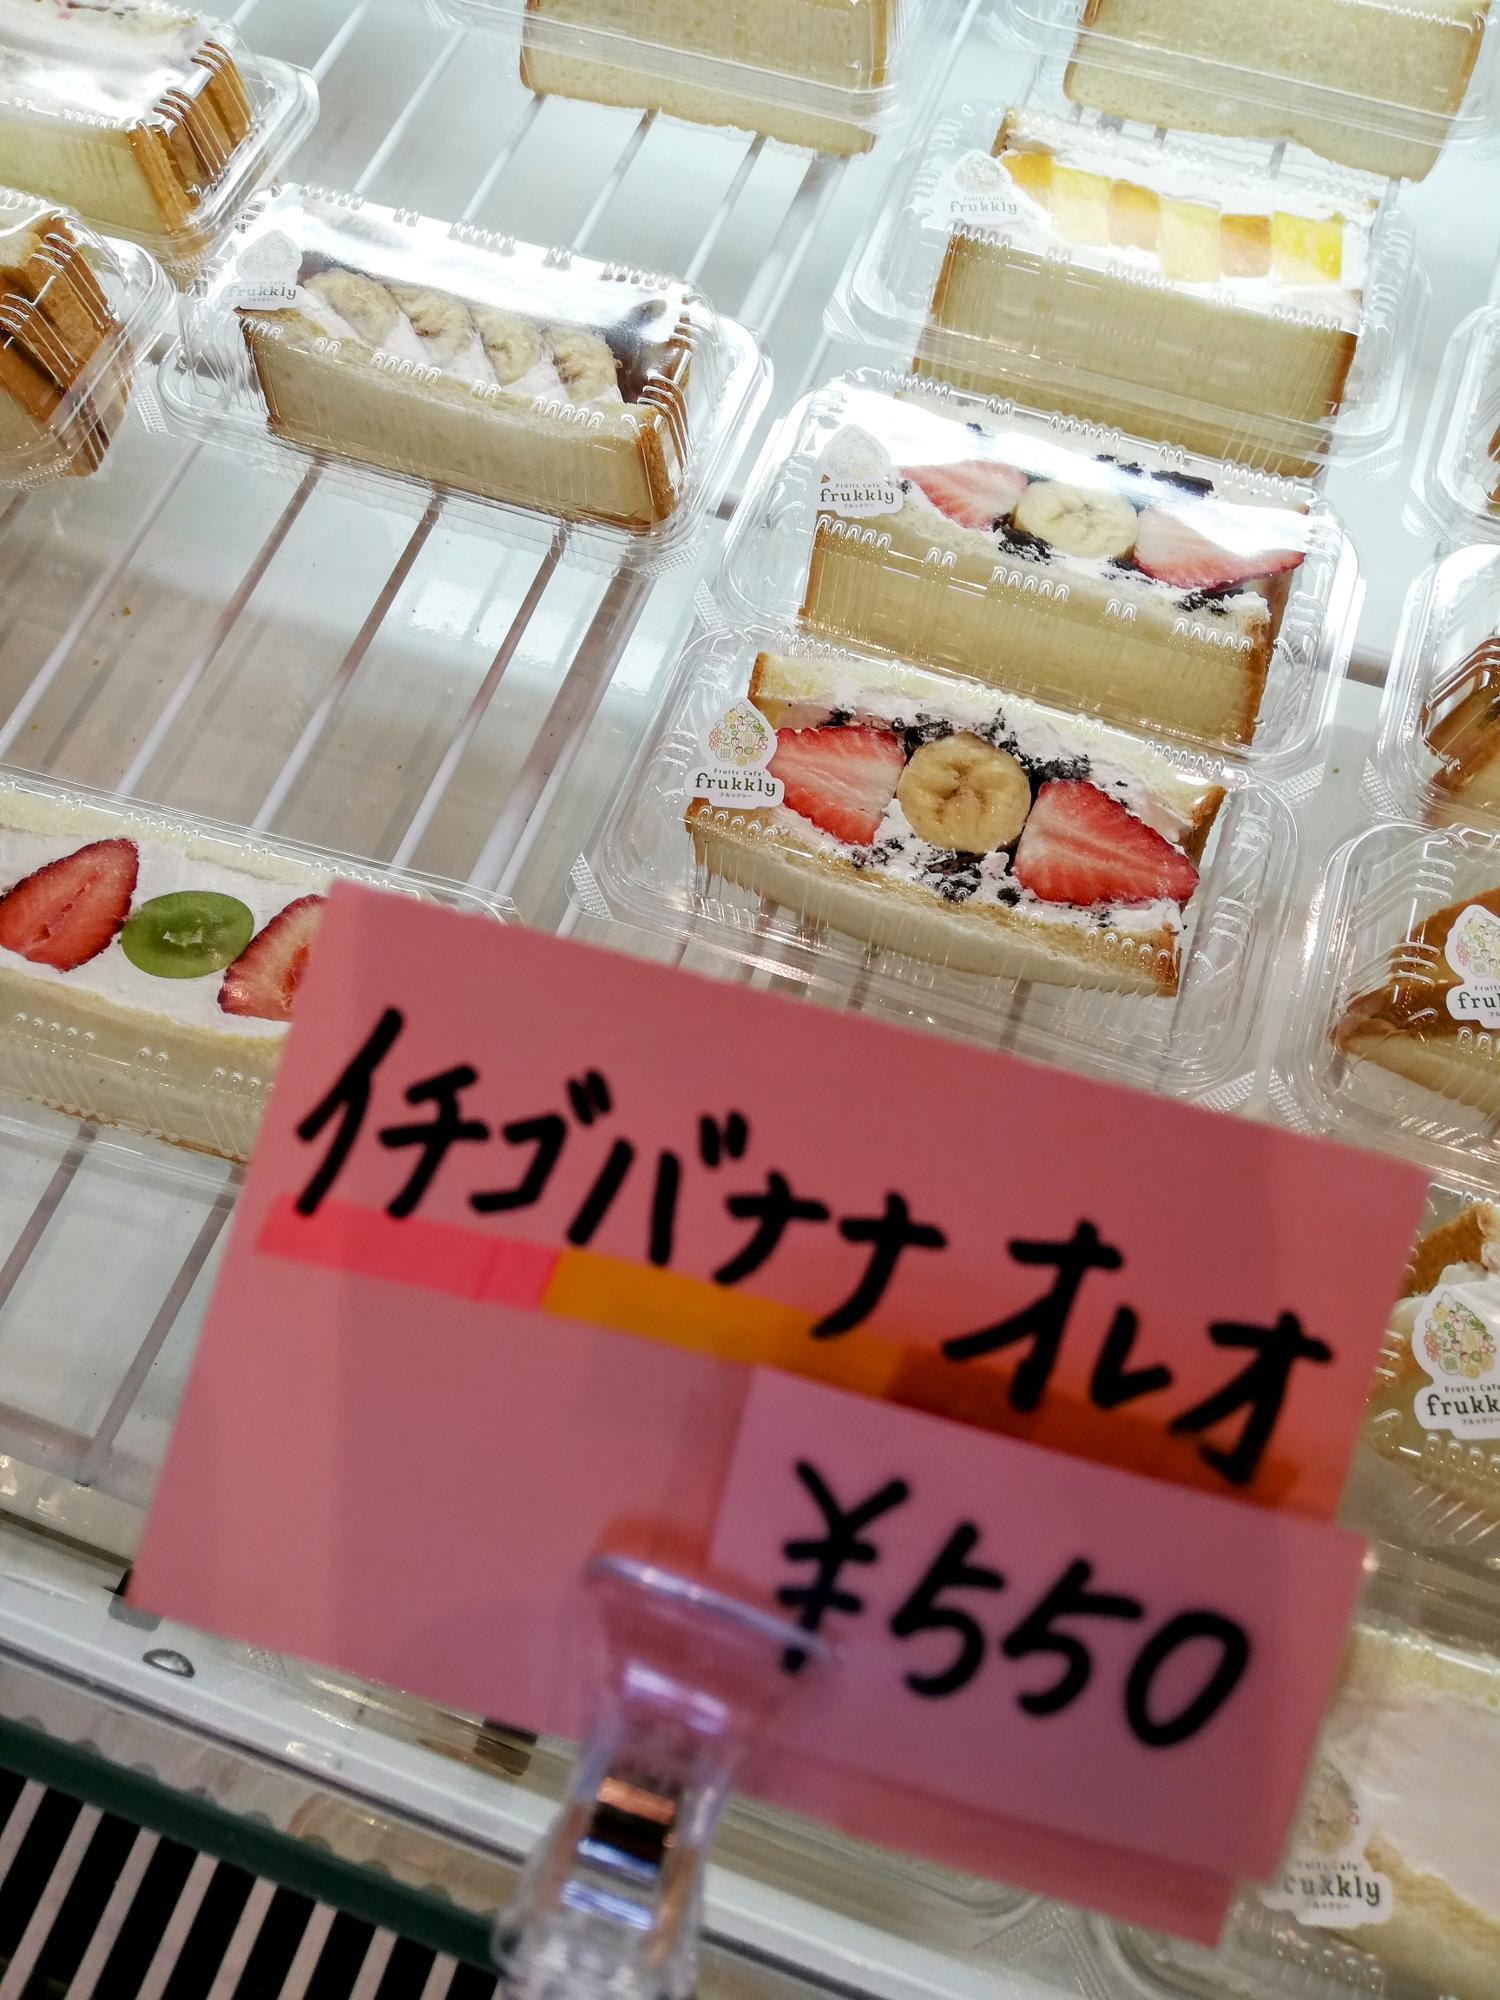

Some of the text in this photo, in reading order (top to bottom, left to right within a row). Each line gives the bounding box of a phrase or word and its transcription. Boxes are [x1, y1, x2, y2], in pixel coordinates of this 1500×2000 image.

[820, 488, 894, 505] frukkly
[713, 768, 739, 776] Fruits
[695, 772, 776, 797] frukkly
[774, 1459, 1255, 1753] ¥550
